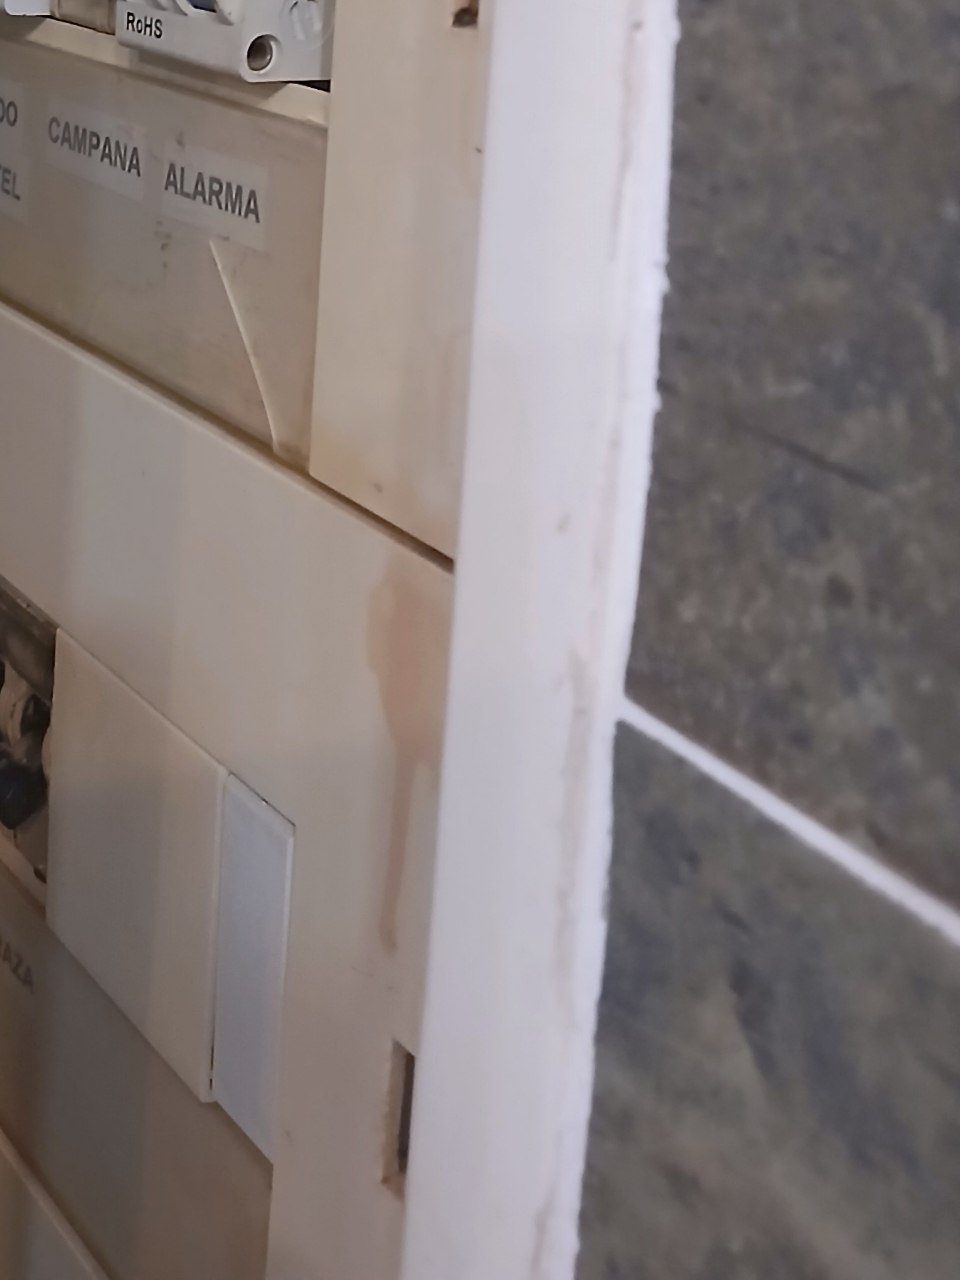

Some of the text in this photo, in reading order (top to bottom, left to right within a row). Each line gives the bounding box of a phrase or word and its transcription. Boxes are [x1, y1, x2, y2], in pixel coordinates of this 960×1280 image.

[126, 12, 163, 39] RoHS
[48, 116, 142, 177] CAMPANA
[164, 163, 261, 223] ALARMA
